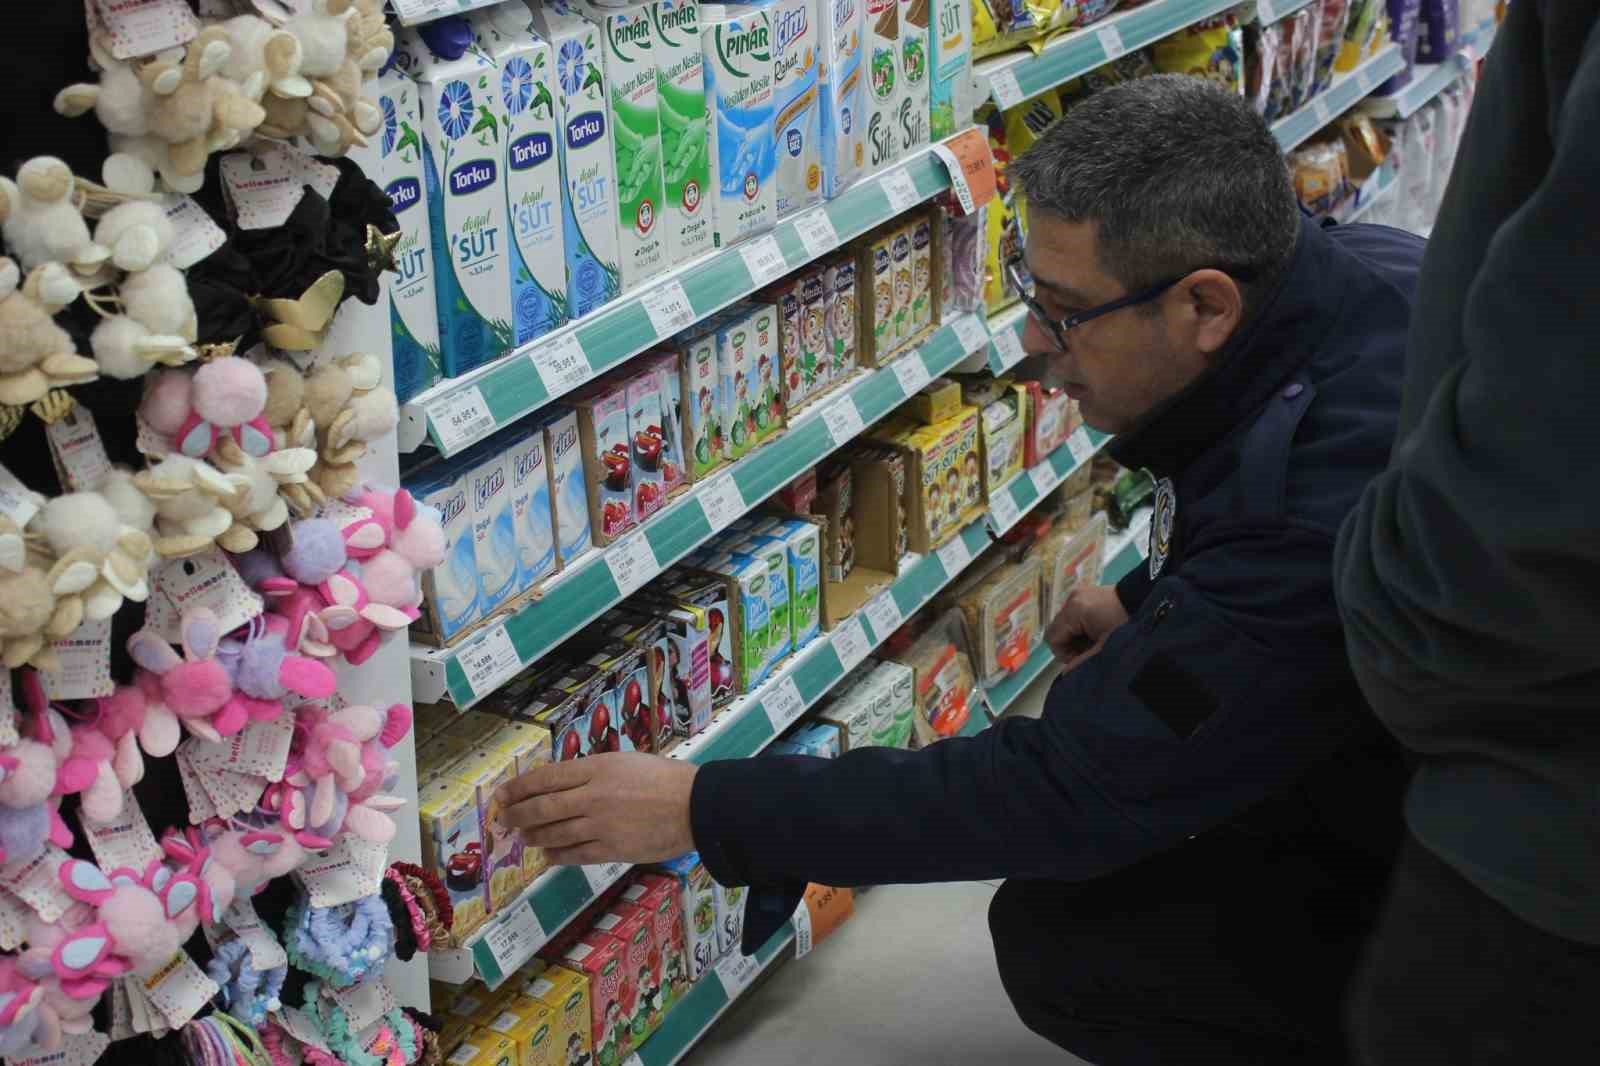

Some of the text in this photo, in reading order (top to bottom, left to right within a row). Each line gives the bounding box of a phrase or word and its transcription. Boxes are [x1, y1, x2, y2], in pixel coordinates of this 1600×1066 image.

[727, 27, 769, 58] PINAR
[569, 119, 600, 143] Torku
[512, 140, 547, 163] Torku
[453, 167, 490, 189] Torku
[459, 228, 498, 262] SÜT
